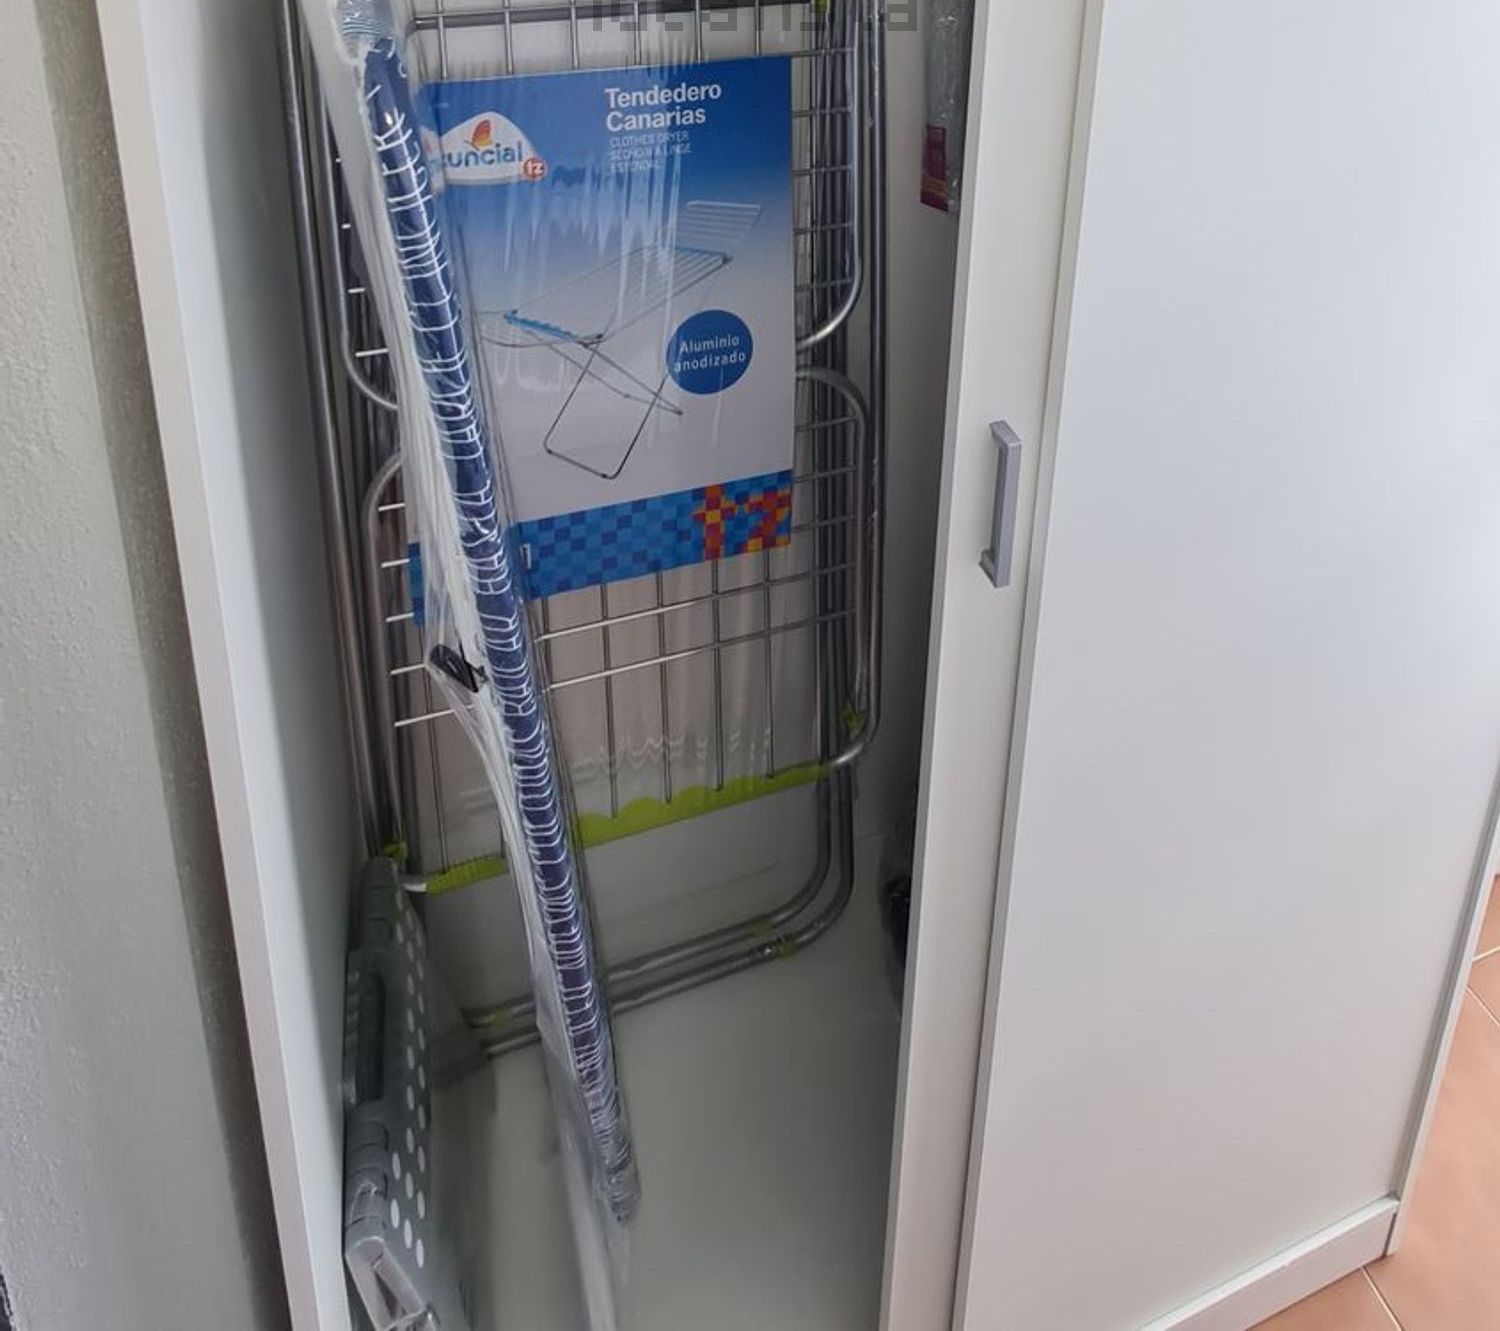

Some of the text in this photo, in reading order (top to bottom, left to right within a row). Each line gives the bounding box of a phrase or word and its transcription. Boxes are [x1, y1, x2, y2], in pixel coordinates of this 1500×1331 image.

[605, 83, 722, 108] Tendedero
[606, 106, 706, 132] Canarias
[679, 334, 740, 356] Aluminio
[674, 350, 746, 372] anodizado
